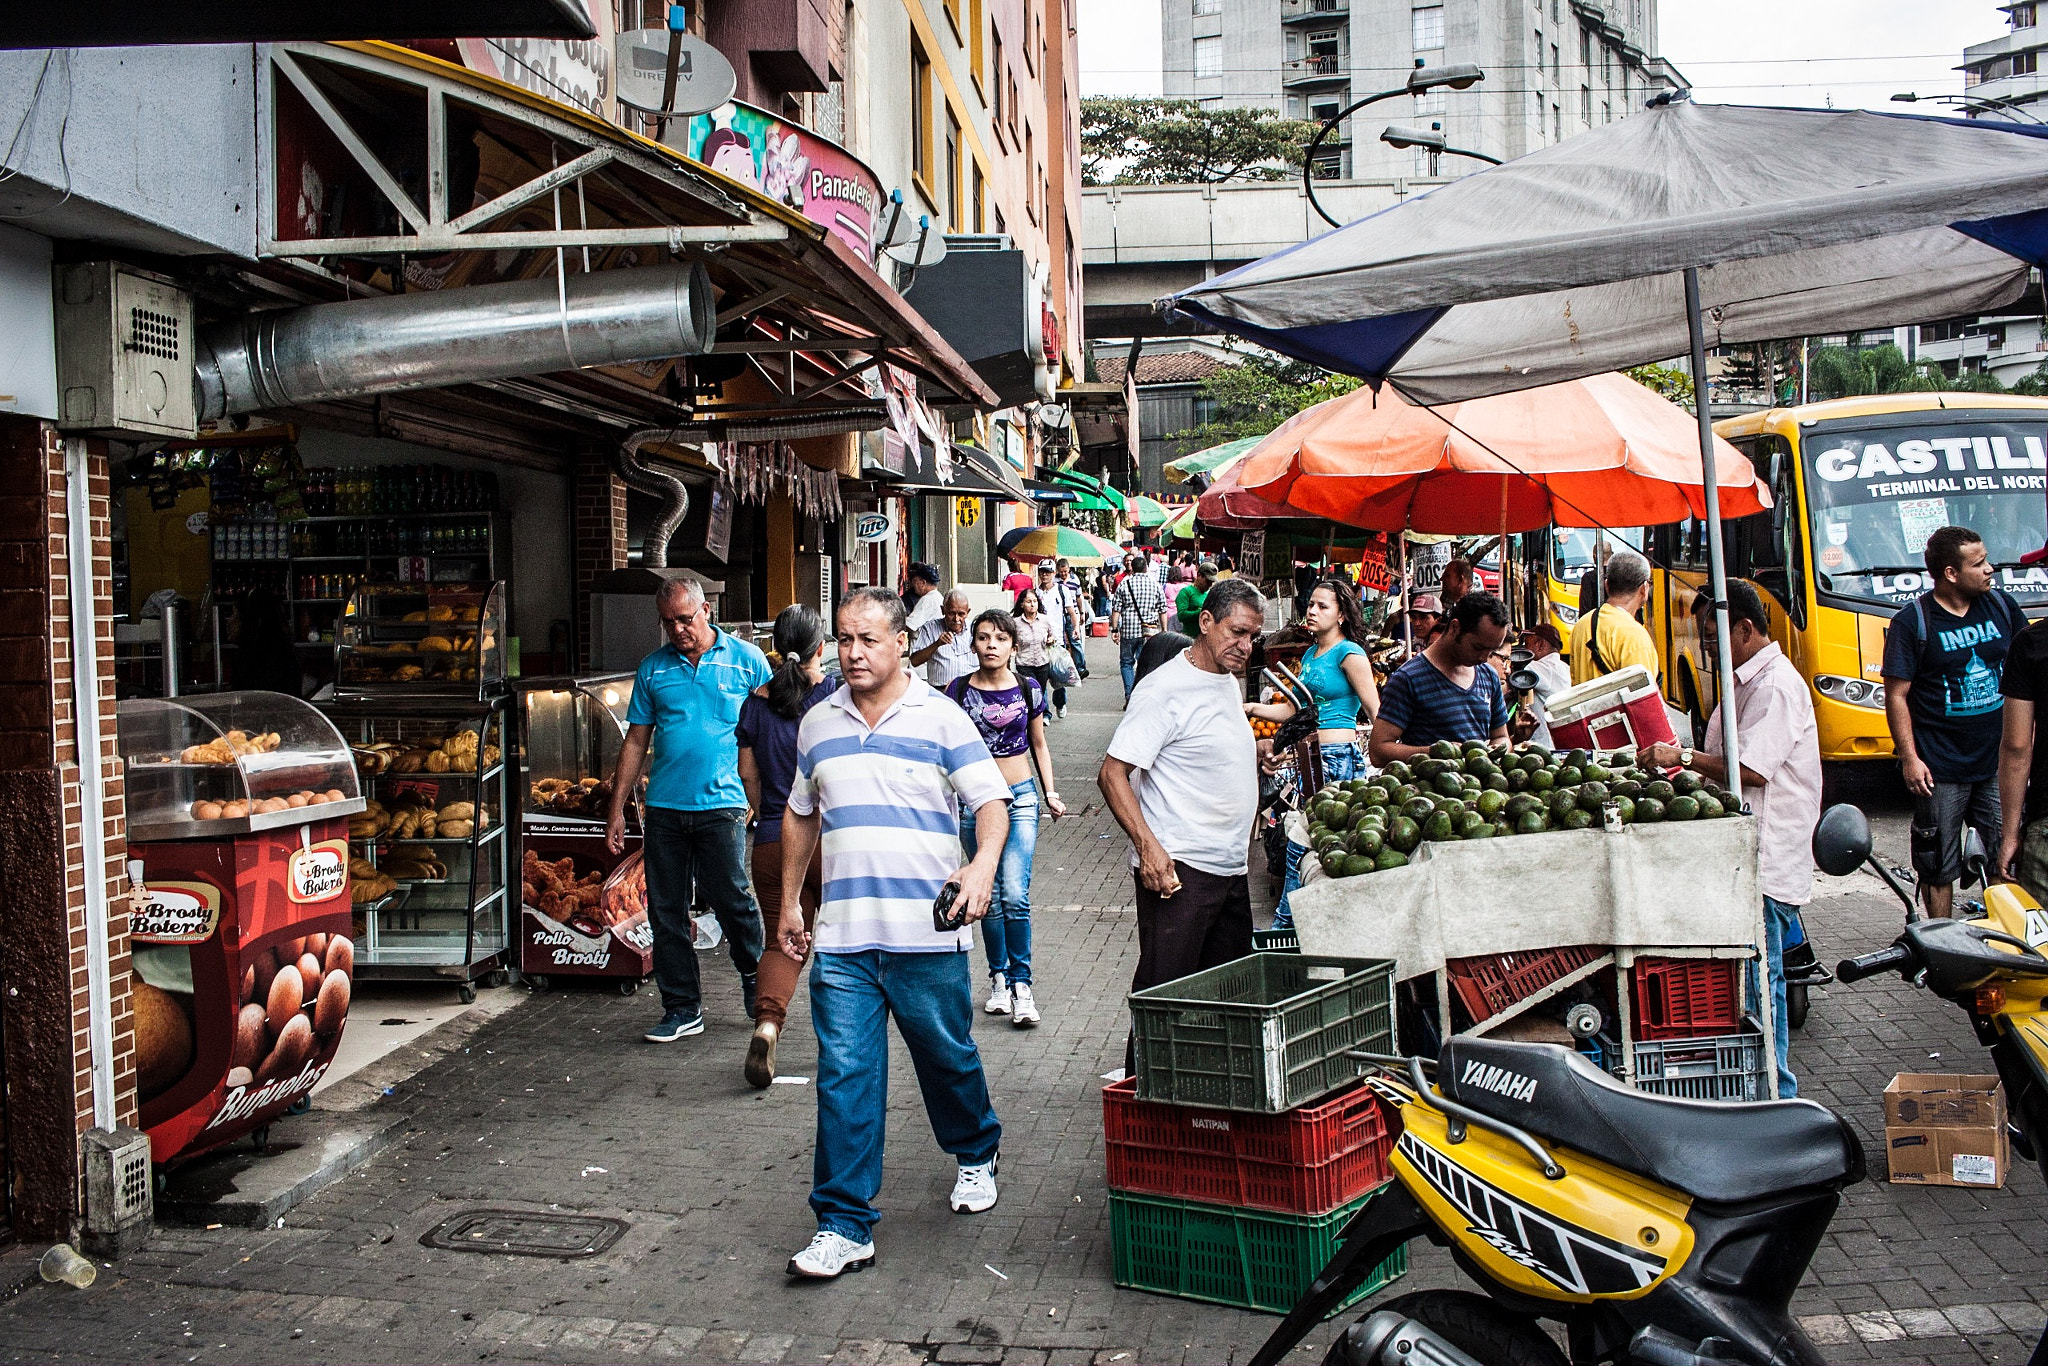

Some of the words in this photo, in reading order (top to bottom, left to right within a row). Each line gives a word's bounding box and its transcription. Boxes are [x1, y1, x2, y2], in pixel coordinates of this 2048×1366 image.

[633, 69, 693, 83] DIRETV
[810, 168, 873, 213] Panadería
[1866, 478, 1961, 498] TERMINAL
[1963, 476, 2000, 491] DEL
[960, 500, 972, 509] ORO
[1901, 499, 1943, 509] 261
[857, 520, 885, 538] Lite
[1938, 620, 2002, 652] INDIA
[312, 859, 345, 879] Brosty
[303, 876, 343, 895] Botero
[144, 903, 214, 924] Brosty
[130, 916, 209, 935] Botero
[532, 931, 574, 945] Pollo
[552, 949, 611, 969] Brosty
[1459, 1058, 1538, 1104] YAMAHA
[205, 1058, 329, 1131] Buñuelos
[1191, 1117, 1230, 1131] NATIPAN
